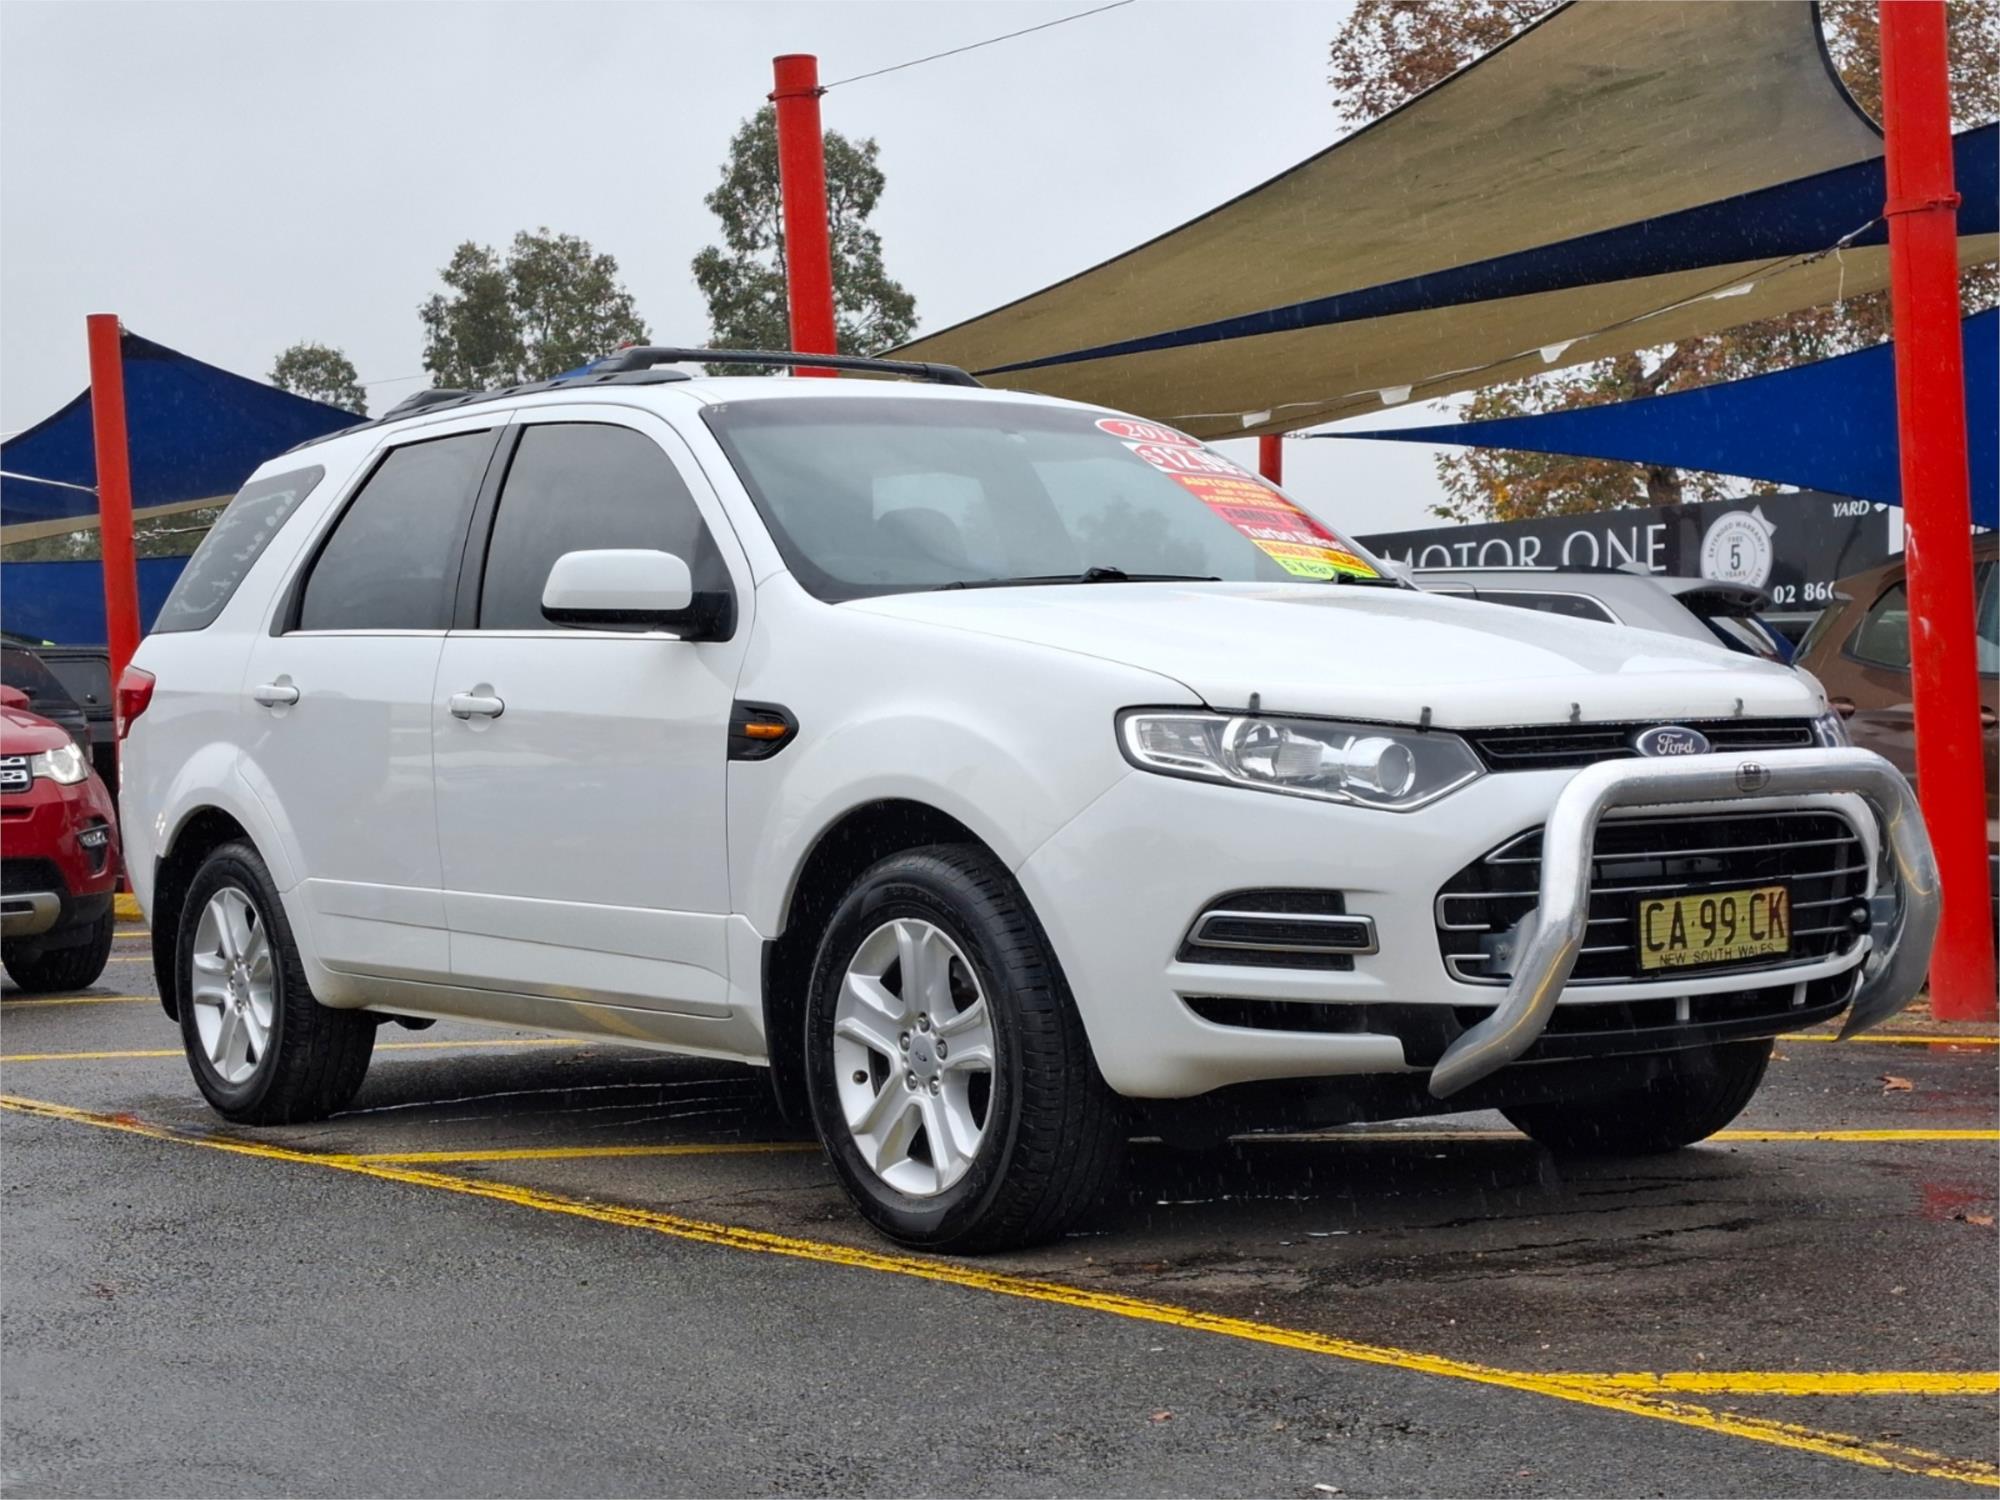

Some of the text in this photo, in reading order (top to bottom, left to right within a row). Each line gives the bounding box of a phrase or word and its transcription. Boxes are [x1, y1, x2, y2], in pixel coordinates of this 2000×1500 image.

[1117, 422, 1187, 445] 2012
[1832, 500, 1870, 517] YARD
[1562, 524, 1667, 572] ONE
[1730, 543, 1742, 571] 5
[1773, 584, 1796, 605] 02
[1656, 732, 1697, 755] Ford
[1645, 890, 1786, 952] CA 99 CK
[1659, 942, 1775, 967] NEW SOUTH WALES
